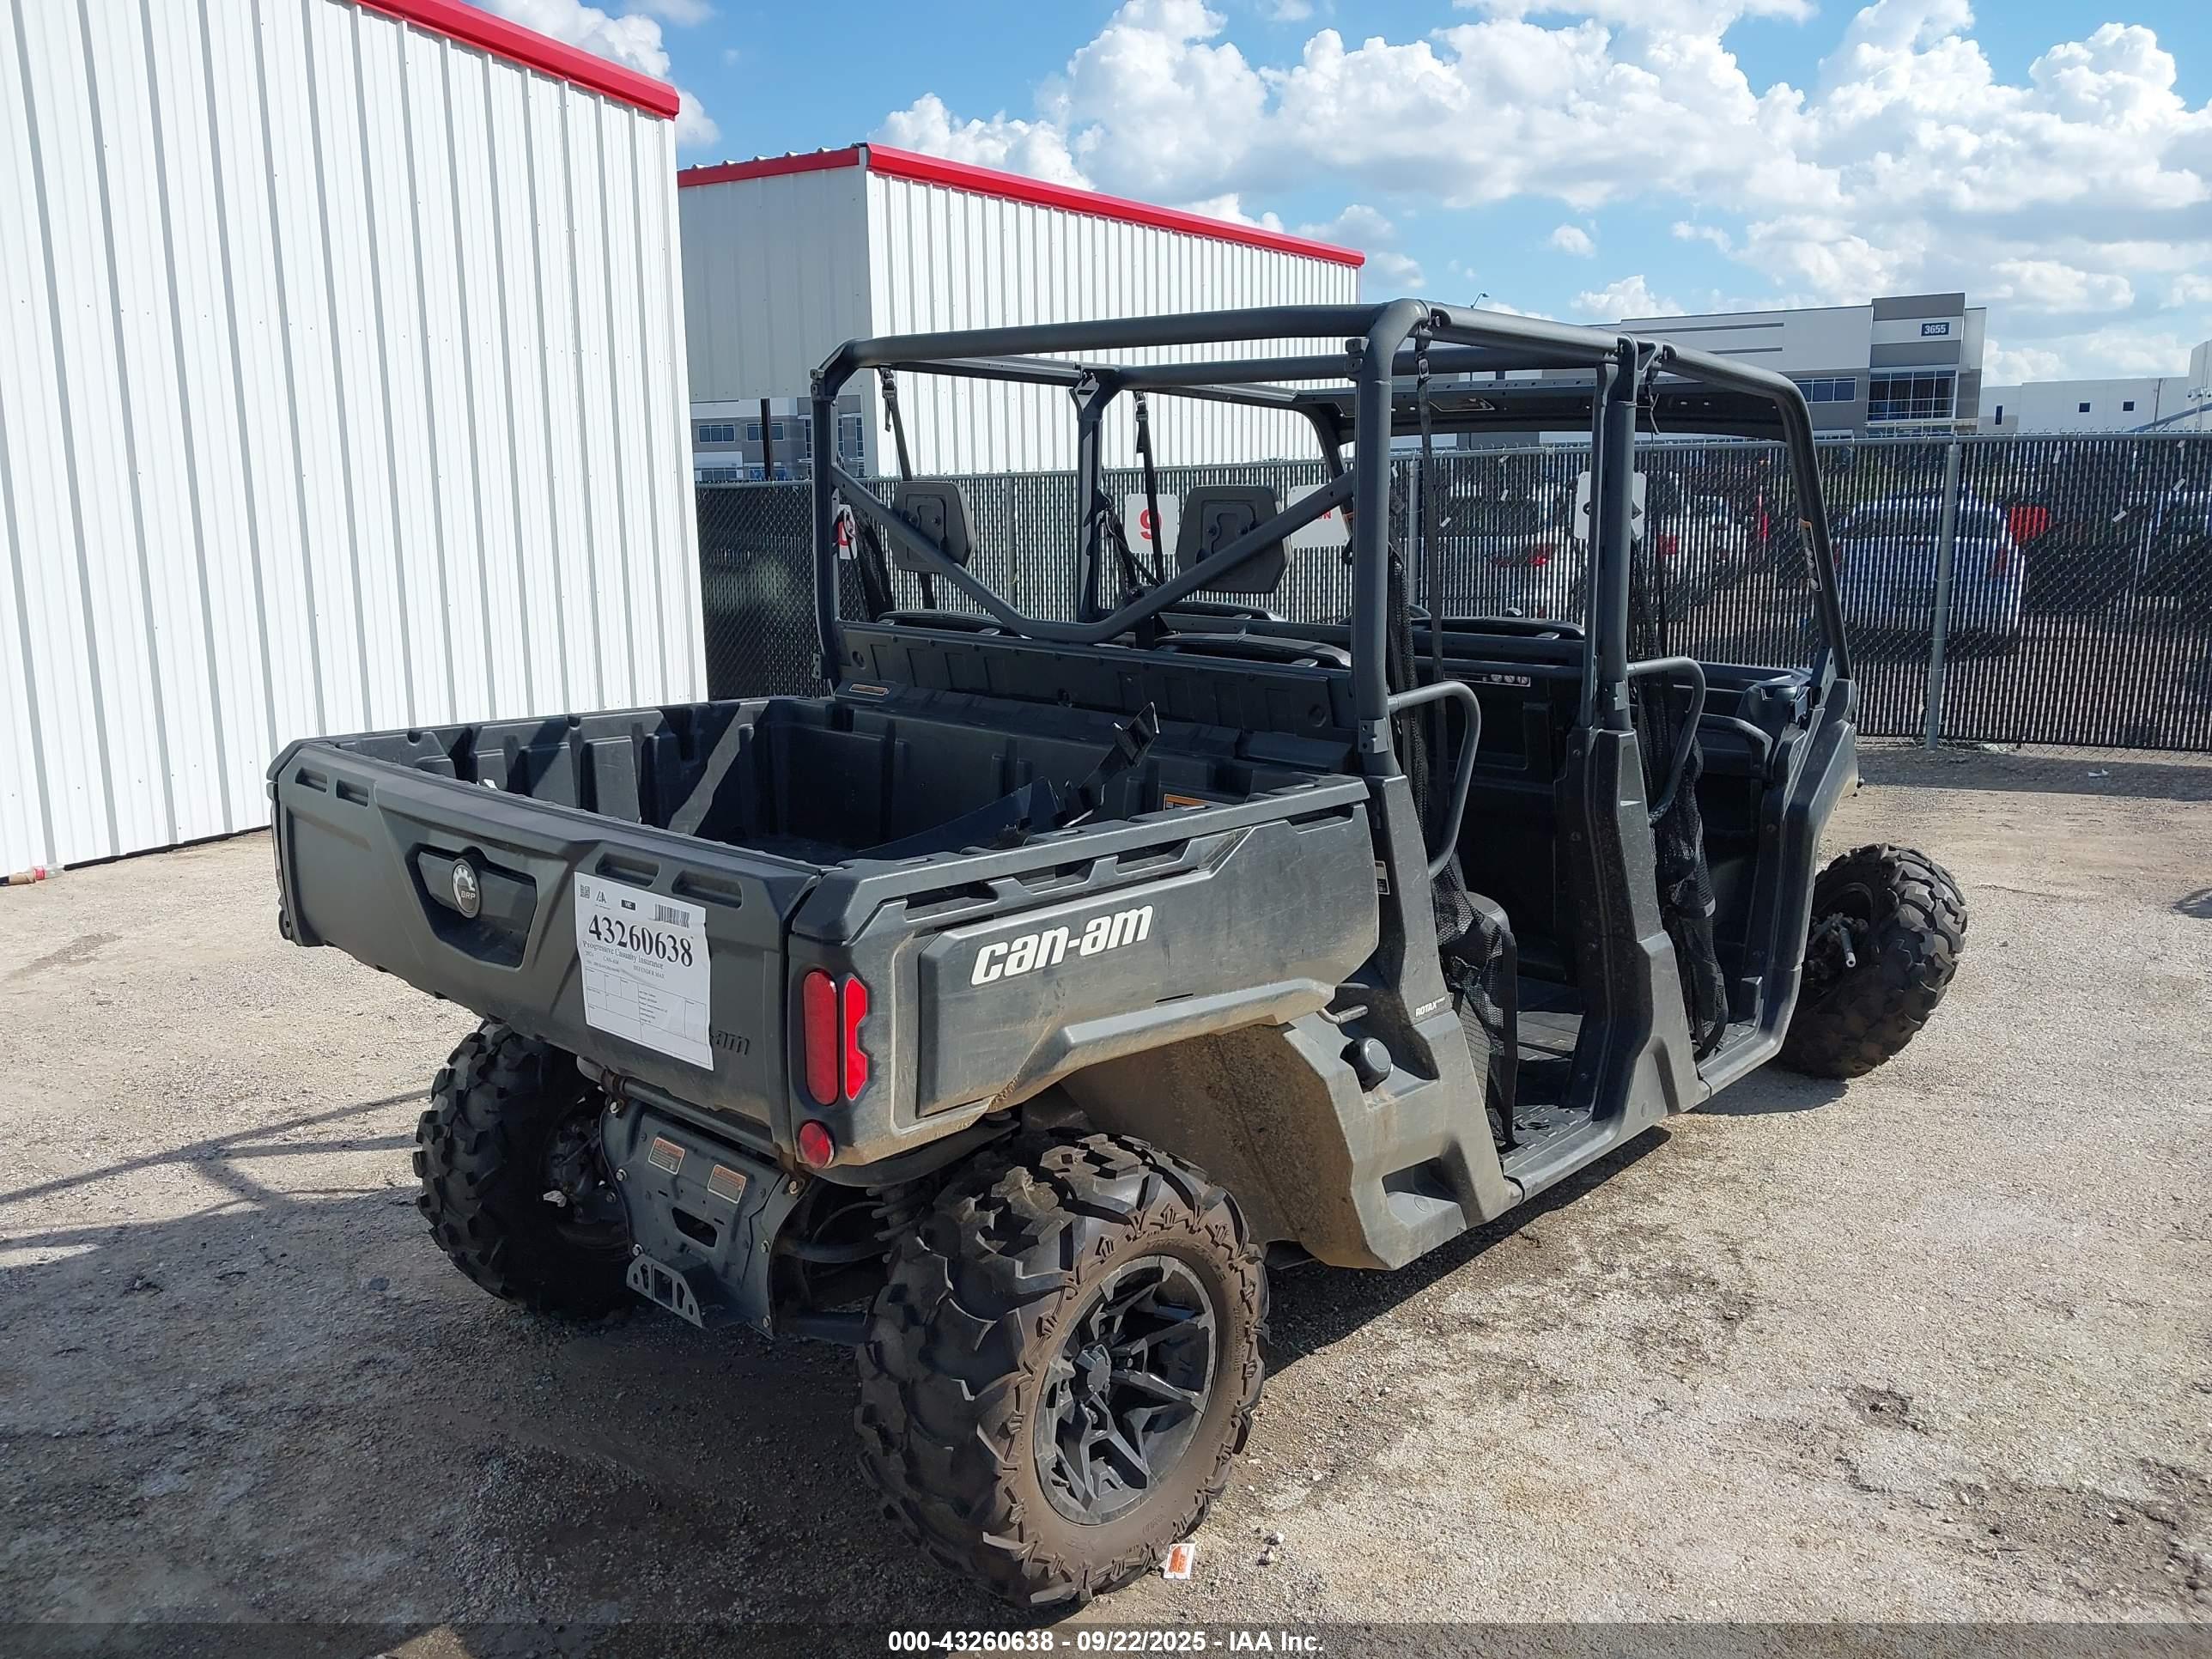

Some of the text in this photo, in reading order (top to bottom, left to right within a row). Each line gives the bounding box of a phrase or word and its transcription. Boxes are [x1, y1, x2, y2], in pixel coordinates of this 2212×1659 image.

[460, 890, 476, 901] BRP
[582, 940, 664, 969] Progressive Casualty Insurance
[588, 914, 693, 968] 43260638
[971, 904, 1154, 986] can-am
[1415, 1000, 1437, 1018] ROTAX
